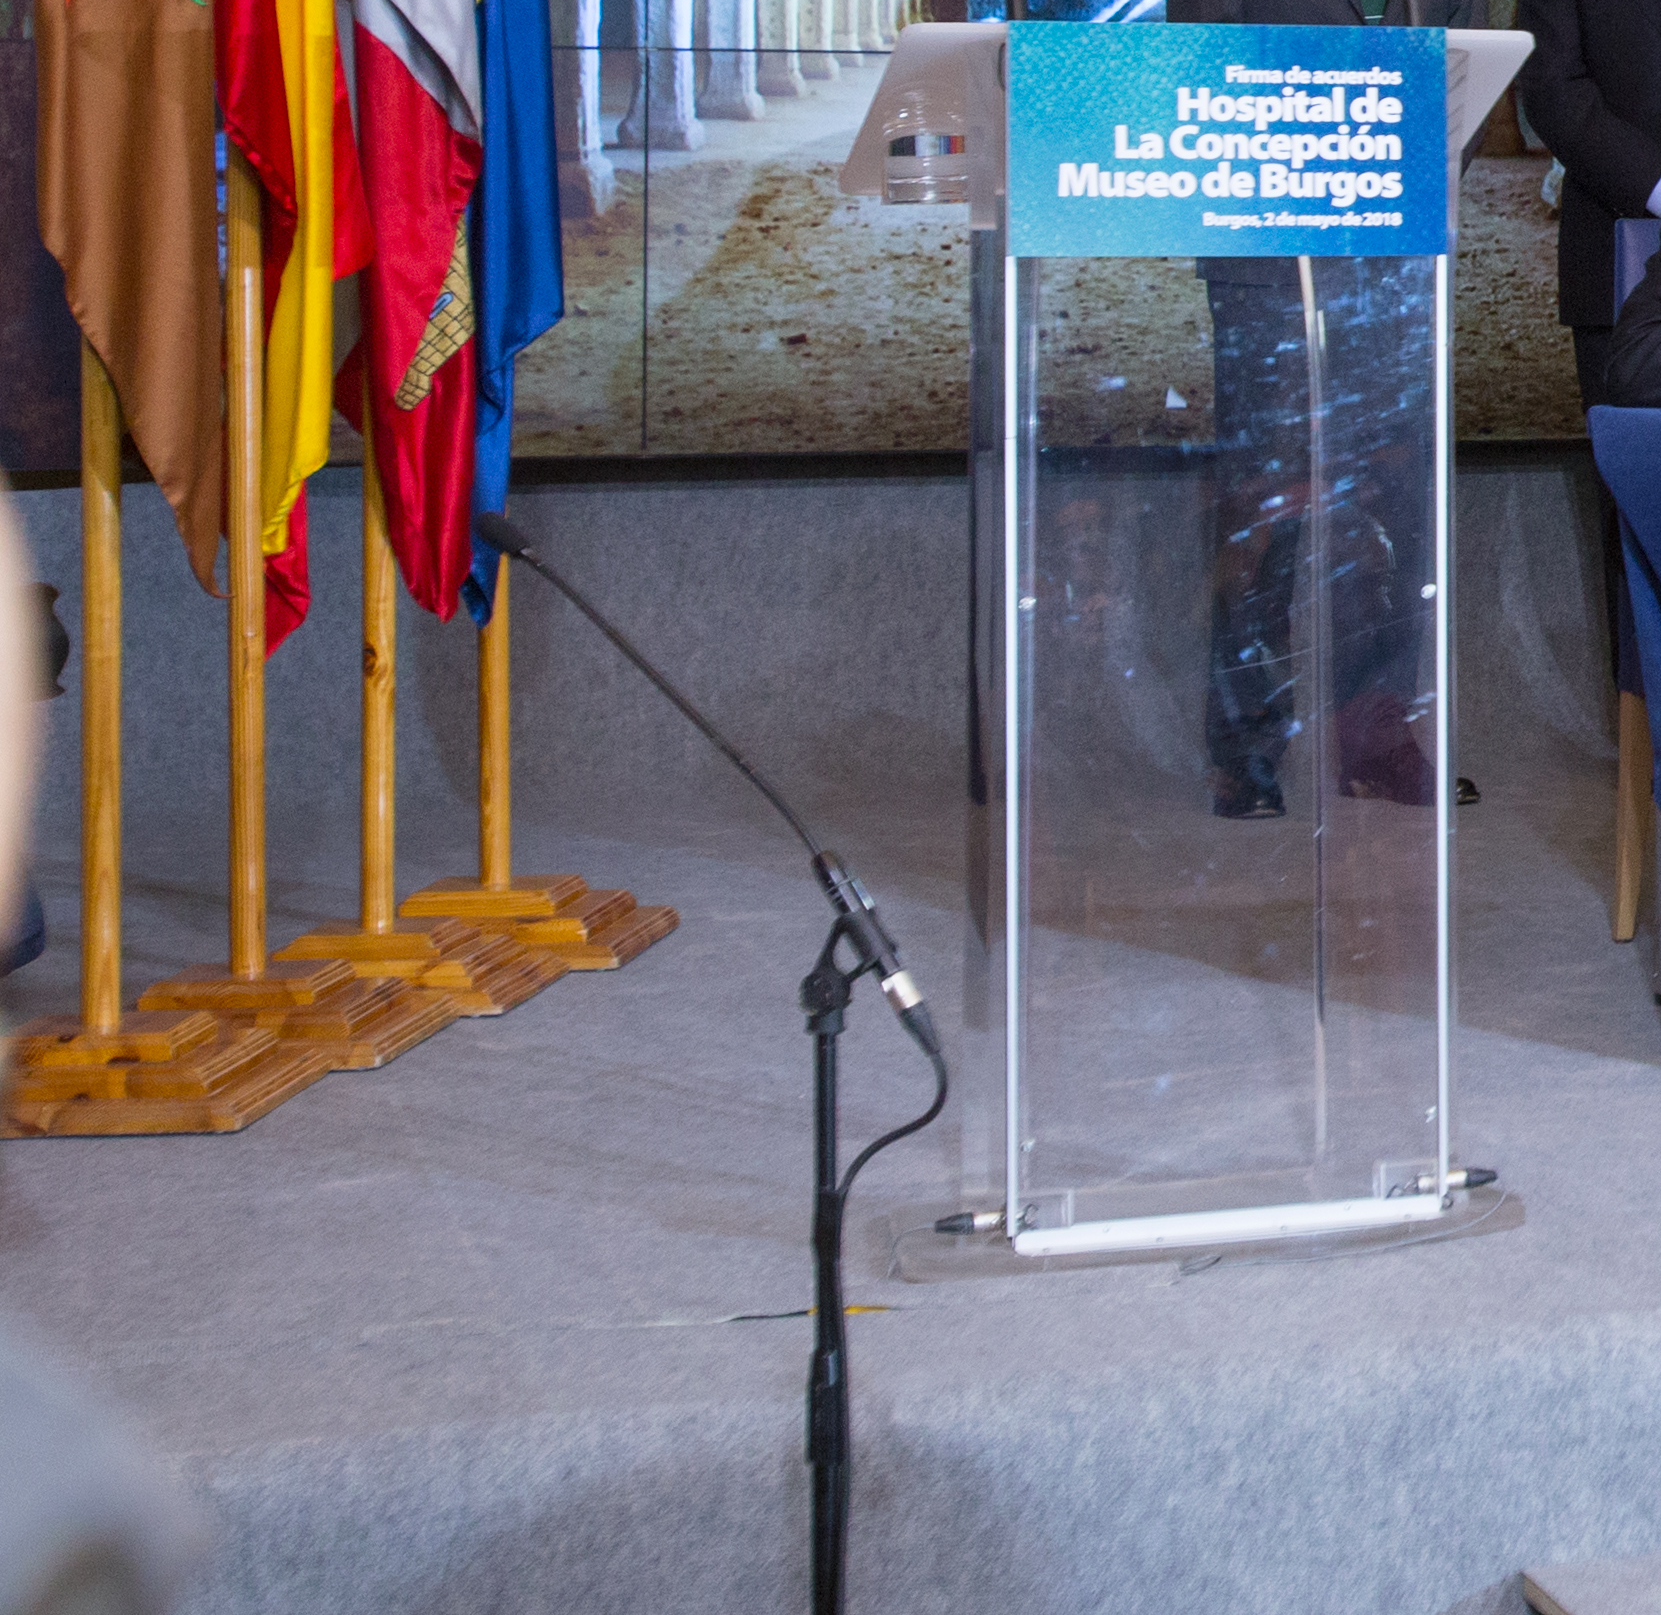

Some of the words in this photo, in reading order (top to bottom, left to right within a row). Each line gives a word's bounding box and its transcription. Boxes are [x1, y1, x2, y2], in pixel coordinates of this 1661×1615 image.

[1225, 65, 1283, 83] Firma
[1284, 65, 1312, 84] de
[1312, 66, 1403, 85] acuerdos
[1177, 87, 1345, 130] Hospital
[1349, 87, 1403, 123] de
[1114, 125, 1164, 159] La
[1169, 125, 1403, 169] Concepción
[1057, 162, 1197, 198] Museo
[1201, 162, 1254, 198] de
[1259, 164, 1403, 207] Burgos
[1202, 211, 1262, 230] Burgos,
[1263, 212, 1275, 226] 2
[1275, 211, 1296, 226] de
[1297, 214, 1341, 230] mayo
[1341, 211, 1362, 226] de
[1362, 212, 1403, 226] 2018
